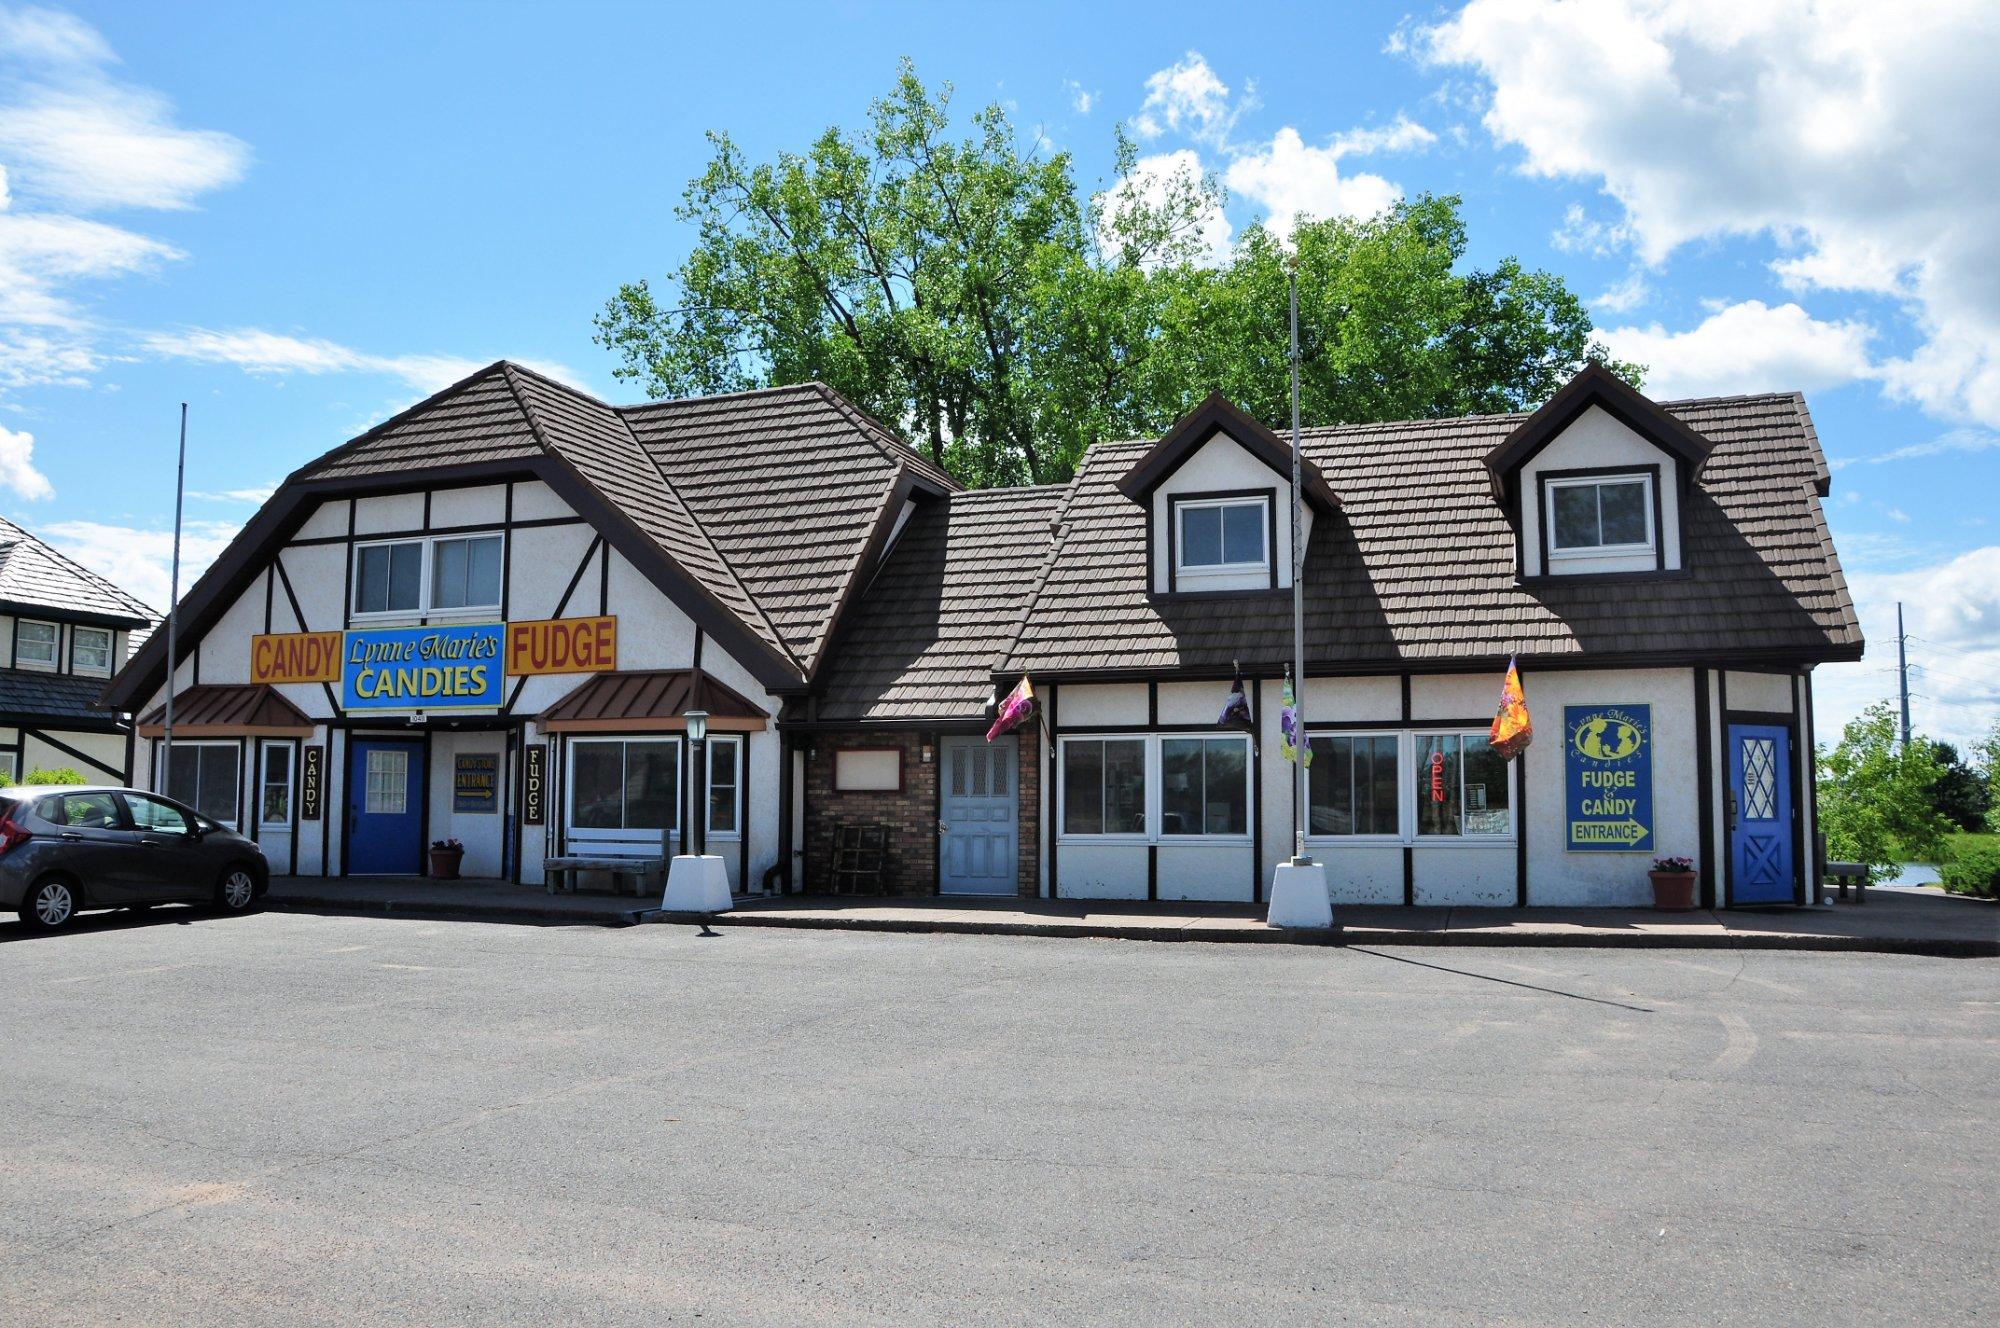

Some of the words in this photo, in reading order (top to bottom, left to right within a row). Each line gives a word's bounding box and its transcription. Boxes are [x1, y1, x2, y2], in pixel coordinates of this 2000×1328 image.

[256, 637, 337, 680] CANDY
[350, 638, 416, 670] Lynne
[419, 632, 498, 660] Marie's
[513, 621, 612, 670] FUDGE
[356, 665, 487, 698] CANDIES
[1432, 752, 1444, 802] OPEN
[1570, 749, 1642, 769] Candies
[305, 750, 317, 815] CANDY
[528, 750, 540, 820] FUDGE
[1582, 771, 1636, 788] FUDGE
[1582, 799, 1637, 815] CANDY
[1575, 824, 1639, 839] ENTRANCE
